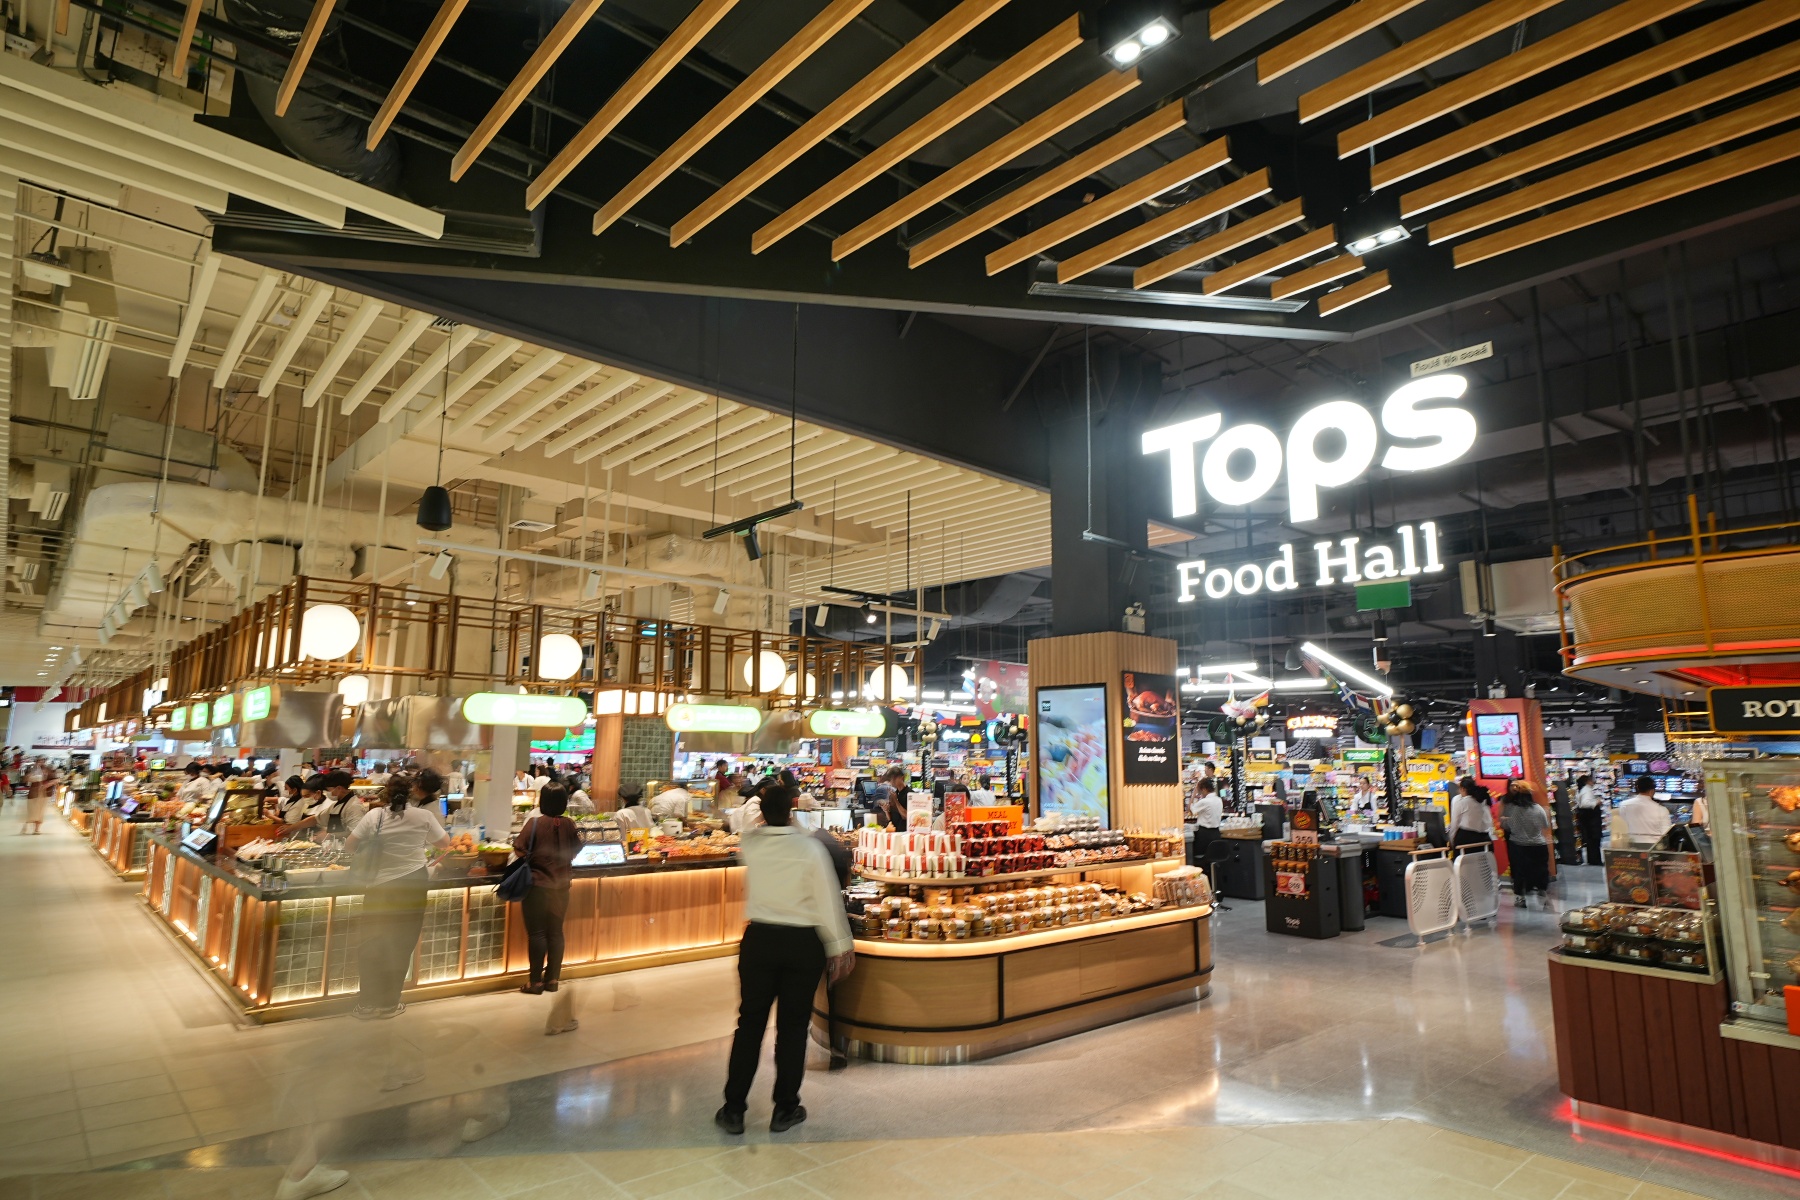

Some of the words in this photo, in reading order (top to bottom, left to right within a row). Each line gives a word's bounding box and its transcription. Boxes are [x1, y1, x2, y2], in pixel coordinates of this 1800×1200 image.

[1141, 373, 1477, 523] Tops
[1177, 543, 1299, 603] Food
[1314, 521, 1443, 587] Hall
[1741, 699, 1800, 718] ROT
[1214, 721, 1227, 740] 4
[1286, 715, 1339, 730] CUISINE
[1363, 717, 1378, 739] 5
[987, 810, 1008, 820] MEAL
[1284, 916, 1301, 927] Tops
